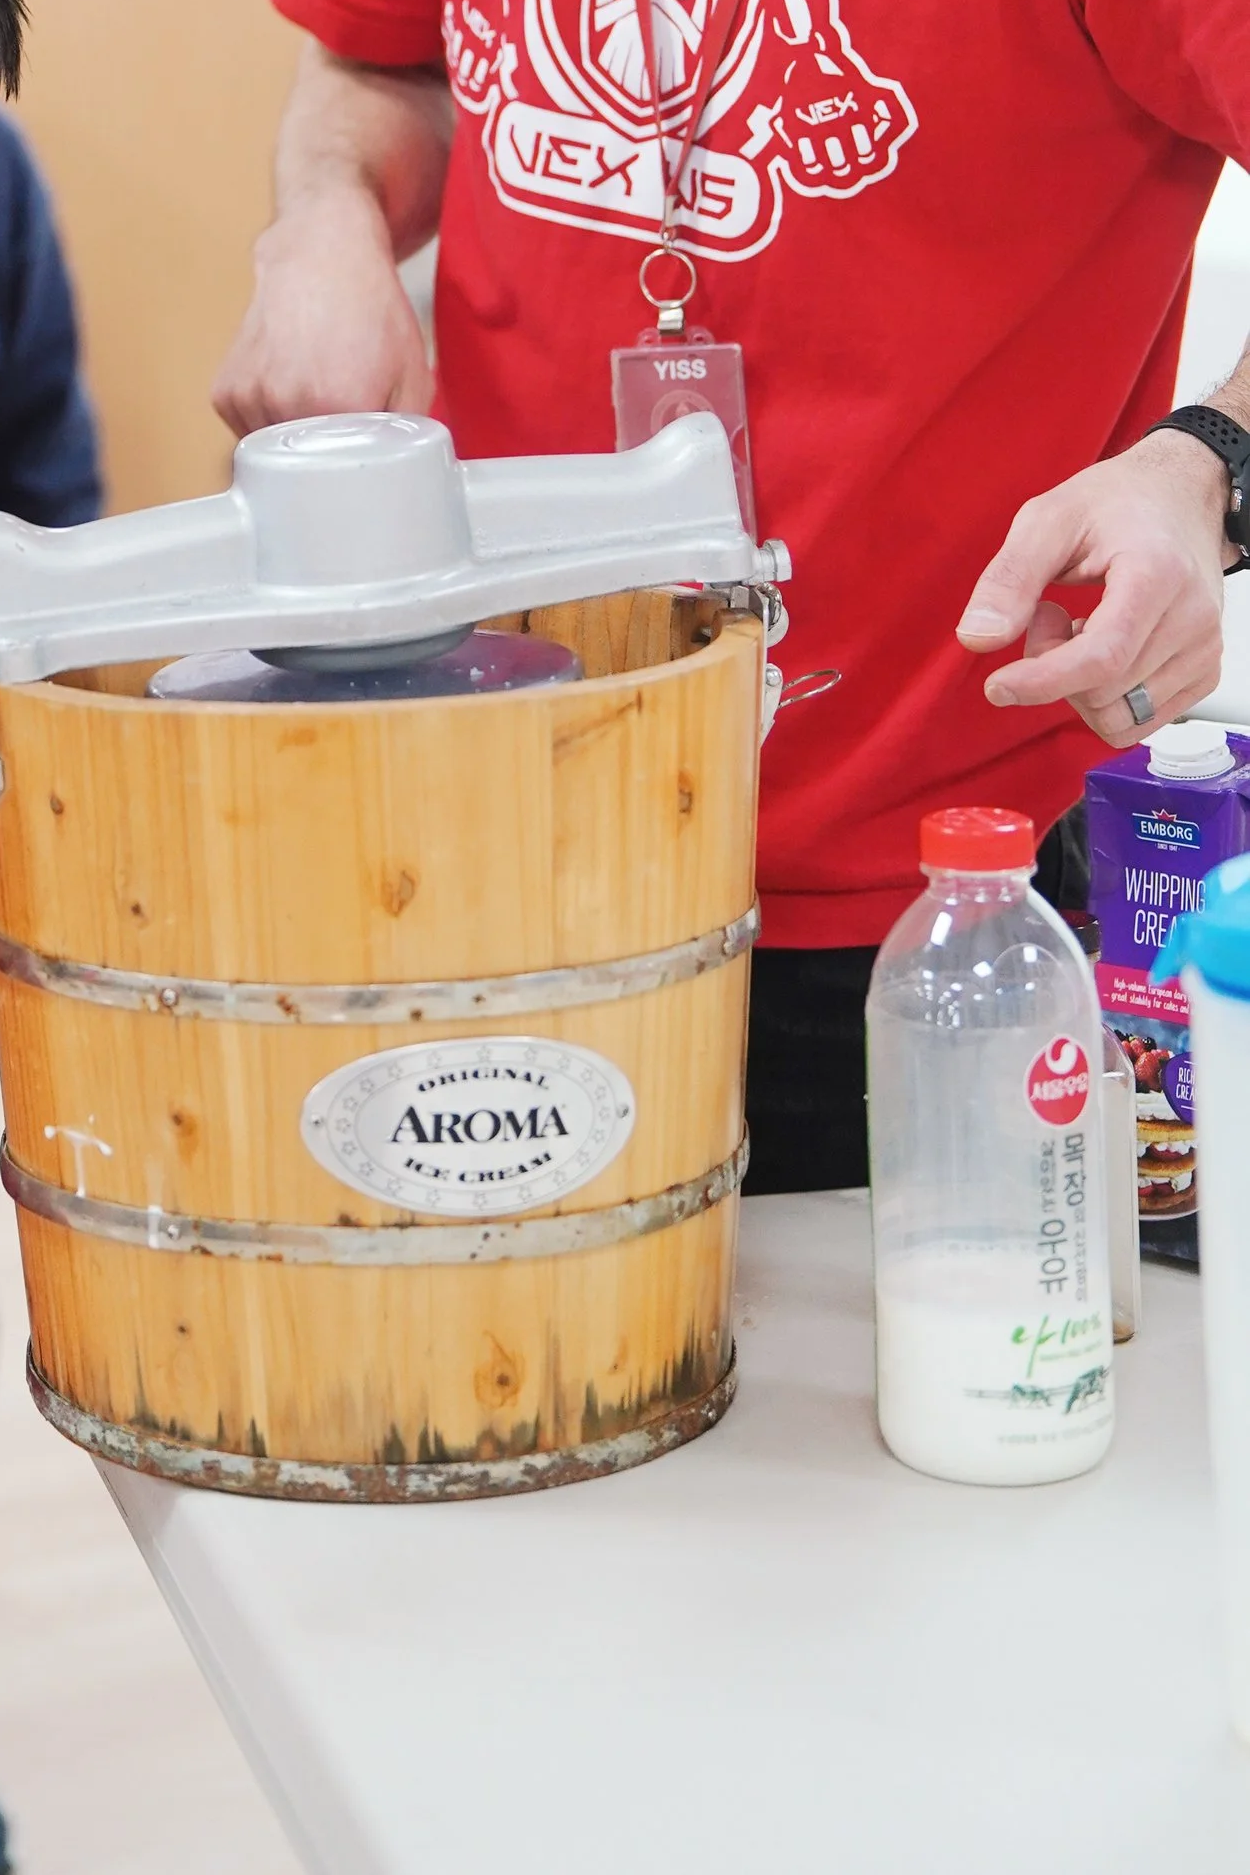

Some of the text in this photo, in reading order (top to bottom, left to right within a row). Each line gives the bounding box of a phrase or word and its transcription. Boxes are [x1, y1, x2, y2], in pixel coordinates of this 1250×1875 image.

[794, 90, 859, 126] VEX
[509, 124, 640, 197] VEX
[653, 359, 707, 381] YISS
[1140, 820, 1193, 841] EMBORG
[1125, 866, 1206, 915] WHIPPING
[417, 1067, 550, 1093] ORIGINAL
[390, 1104, 570, 1145] AROMA
[402, 1151, 554, 1183] ICE CREAM
